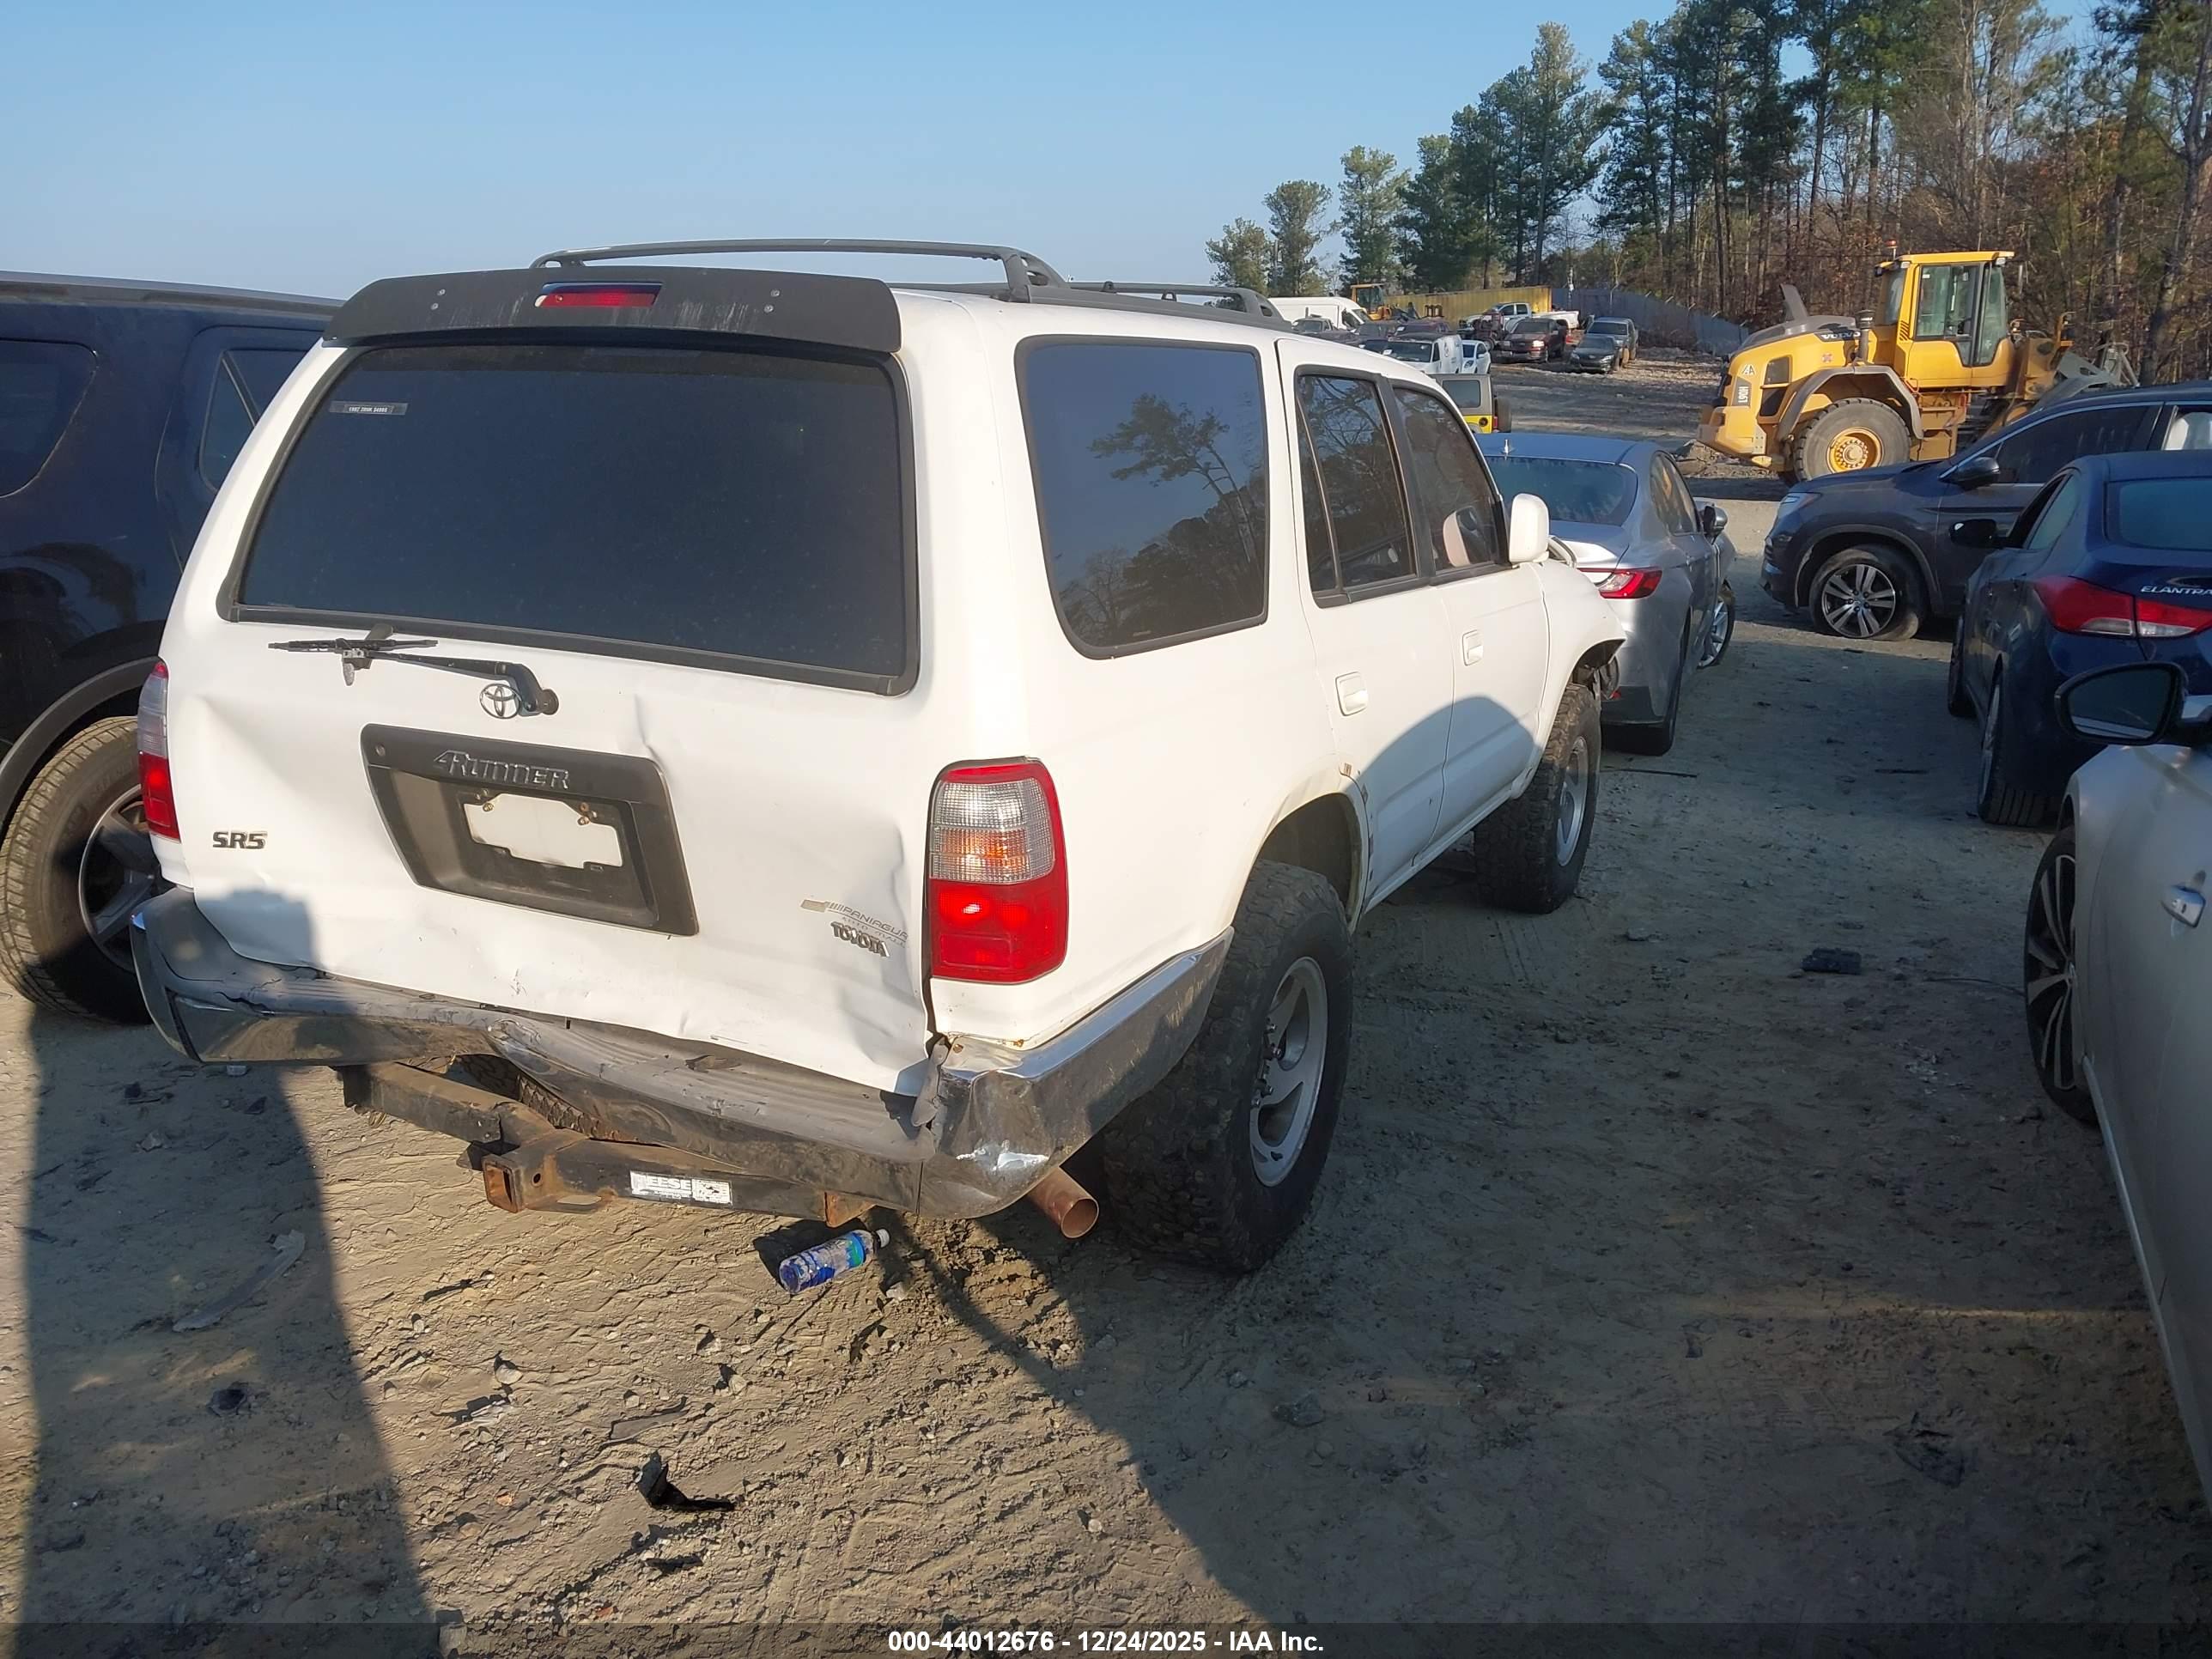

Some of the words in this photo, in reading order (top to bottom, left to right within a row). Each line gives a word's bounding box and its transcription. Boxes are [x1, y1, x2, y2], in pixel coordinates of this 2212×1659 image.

[1820, 331, 1861, 340] VOLVO
[1737, 386, 1749, 404] L90H
[2141, 586, 2212, 596] ELANTRA
[212, 830, 268, 849] SR5
[830, 921, 890, 957] TOYOTA
